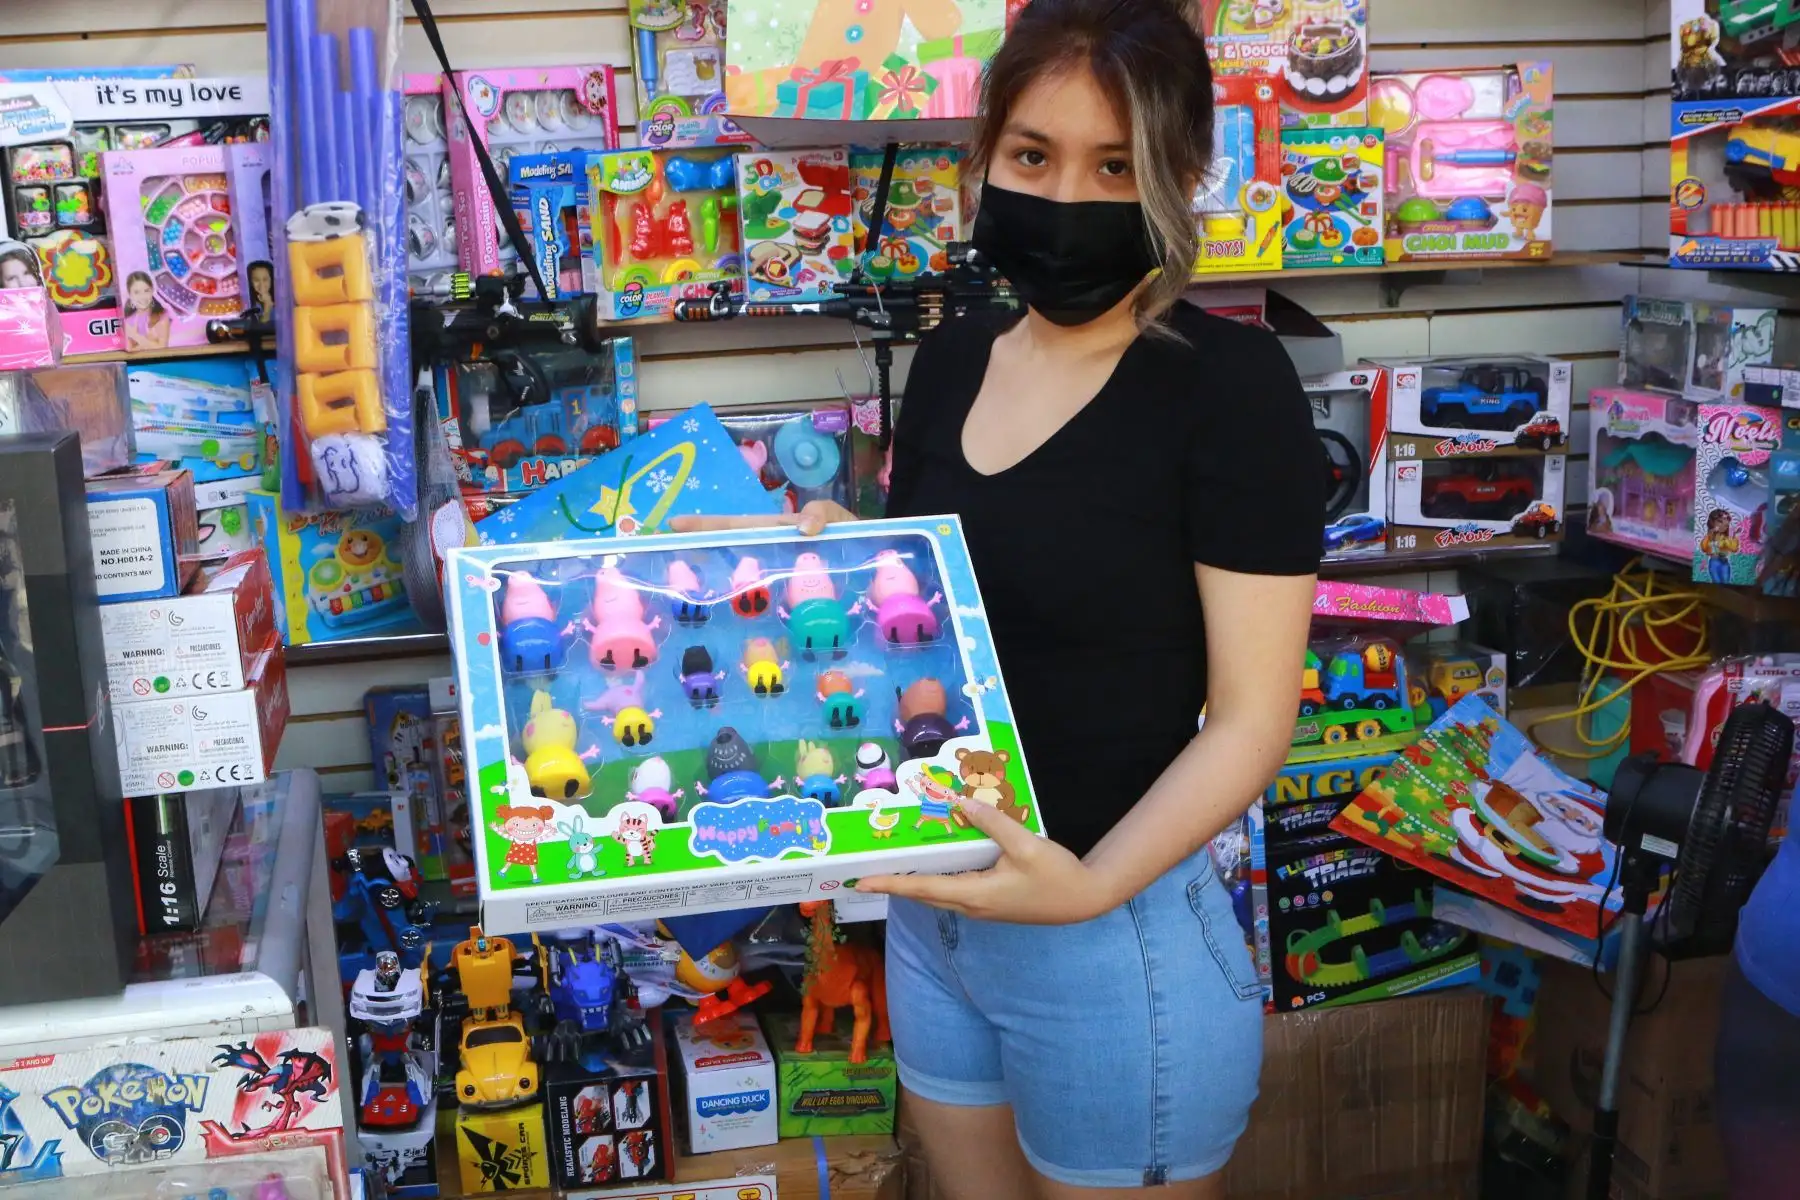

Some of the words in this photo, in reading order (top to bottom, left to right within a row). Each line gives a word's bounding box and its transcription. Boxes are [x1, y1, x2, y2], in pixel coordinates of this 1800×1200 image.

[1241, 43, 1289, 57] DOUGH
[96, 84, 138, 105] it's
[145, 86, 183, 107] my
[191, 82, 242, 102] love
[648, 122, 675, 133] COLOR
[520, 164, 557, 180] Modeling
[538, 197, 555, 243] SAND
[479, 200, 495, 265] Porcelain
[1205, 239, 1245, 258] TOYS!
[1406, 234, 1457, 251] CHOI
[1463, 233, 1510, 251] MUD
[543, 244, 558, 300] Modeling
[620, 294, 643, 304] COLOR
[88, 318, 121, 336] GIF
[571, 399, 581, 415] 1
[1394, 443, 1416, 458] 1:16
[1434, 438, 1499, 457] FAMOUS
[1395, 535, 1416, 549] 1:16
[1434, 528, 1496, 548] FAMOUS
[100, 548, 120, 556] MADE
[103, 571, 138, 580] CONTENTS
[1336, 596, 1401, 613] Fashion
[123, 648, 165, 659] WARNING:
[146, 743, 189, 753] WARNING:
[1280, 809, 1337, 831] TRACK
[697, 824, 759, 845] Happy
[759, 818, 821, 836] Family
[155, 844, 169, 878] Scale
[1304, 857, 1383, 888] TRACK
[526, 896, 588, 907] SPECIFICATIONS
[590, 892, 629, 900] COLOURS
[648, 886, 690, 894] CONTENTS
[754, 873, 814, 883] ILLUSTRATIONS
[622, 893, 681, 904] PRECAUCIONES:
[160, 882, 180, 926] 1:16
[555, 901, 600, 912] WARNING:
[1306, 991, 1326, 1003] PCS
[701, 1096, 741, 1109] DANCING
[742, 1094, 766, 1106] DUCK
[829, 1096, 845, 1105] EGGS
[559, 1096, 570, 1136] MODELING
[518, 1122, 527, 1143] CAR
[108, 1149, 174, 1166] PLUS
[563, 1136, 575, 1177] REALISTIC
